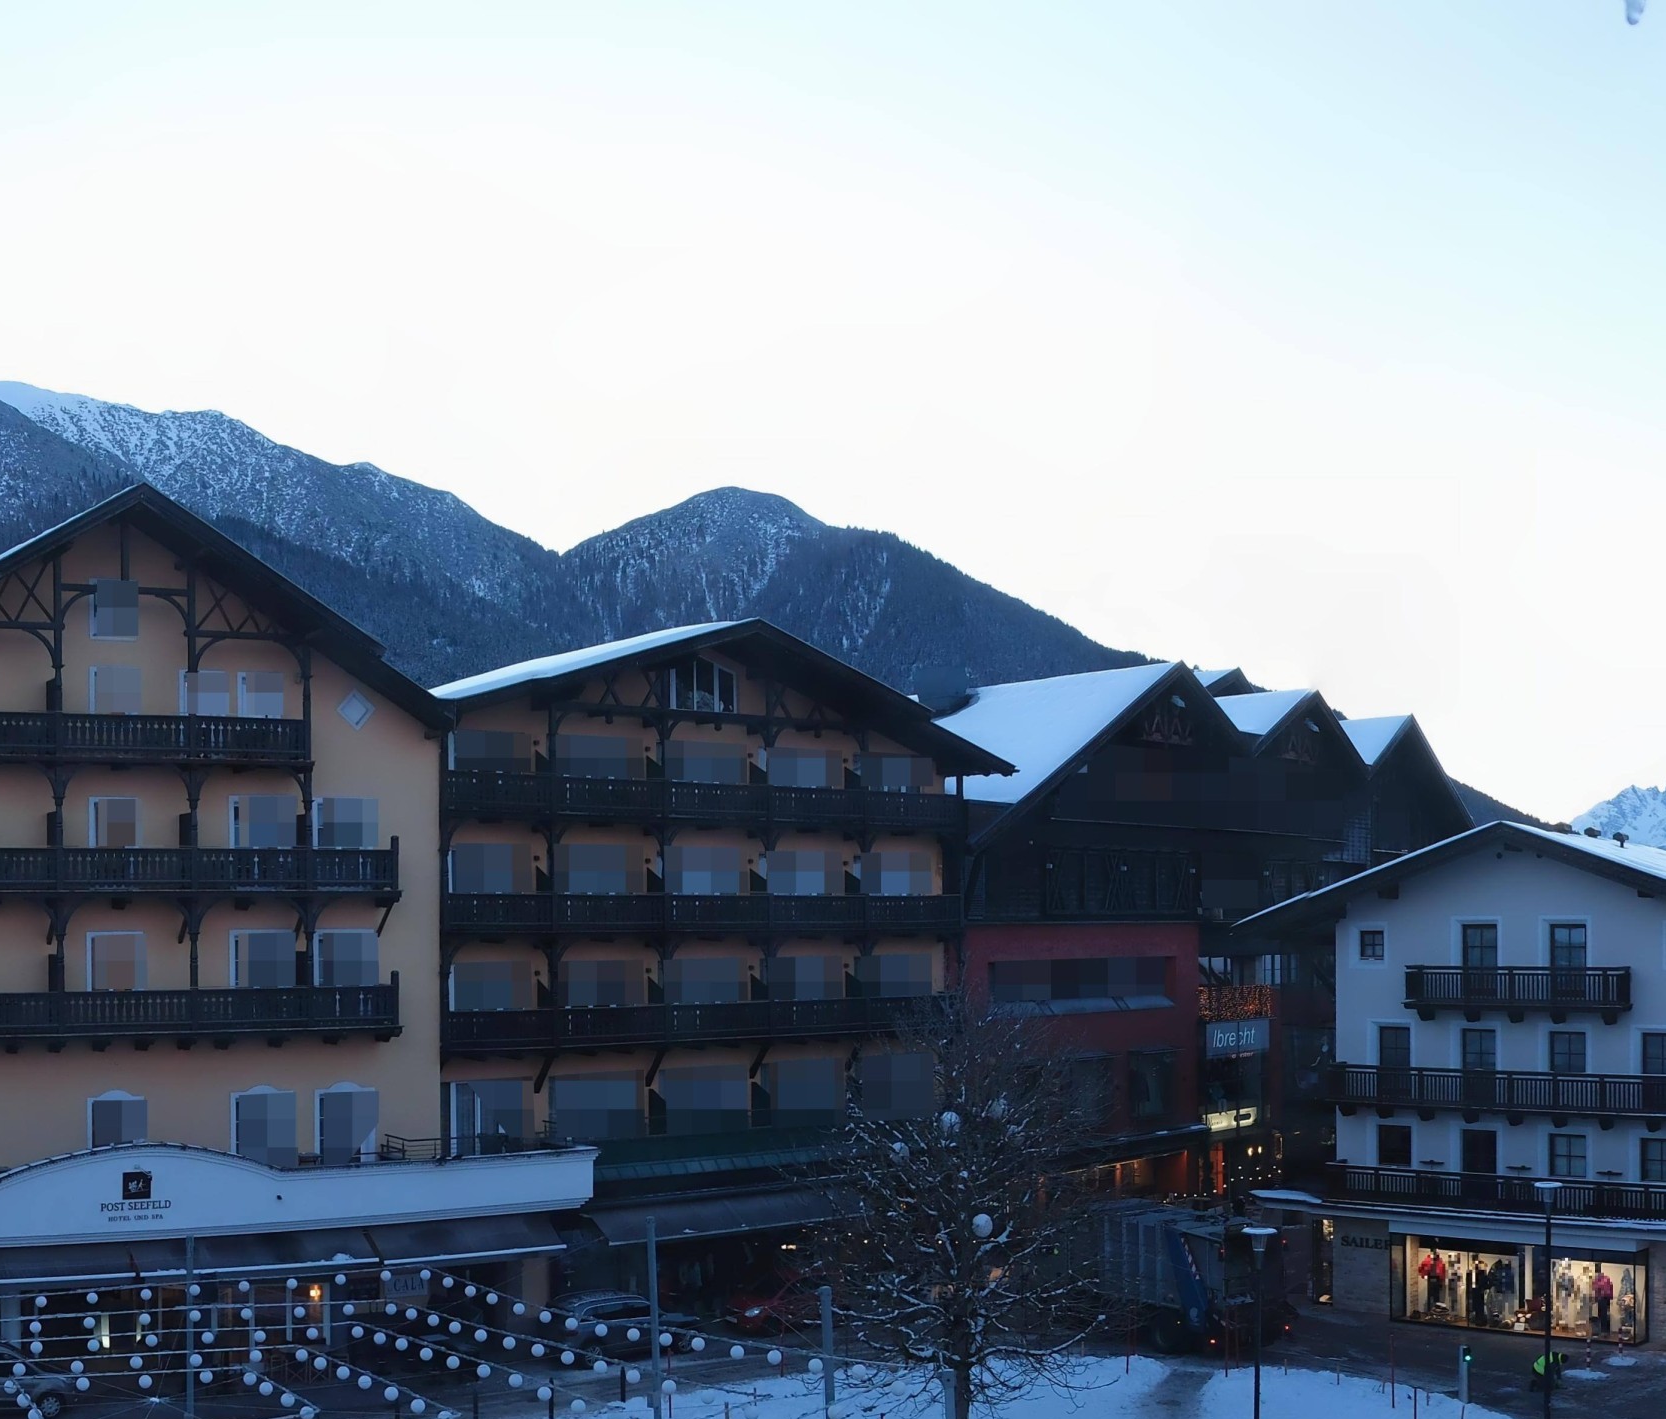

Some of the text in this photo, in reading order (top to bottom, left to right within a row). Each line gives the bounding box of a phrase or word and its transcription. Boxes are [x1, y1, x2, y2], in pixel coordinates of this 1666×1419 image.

[100, 1200, 172, 1212] POST SEEFELD
[388, 1277, 425, 1292] CALA
